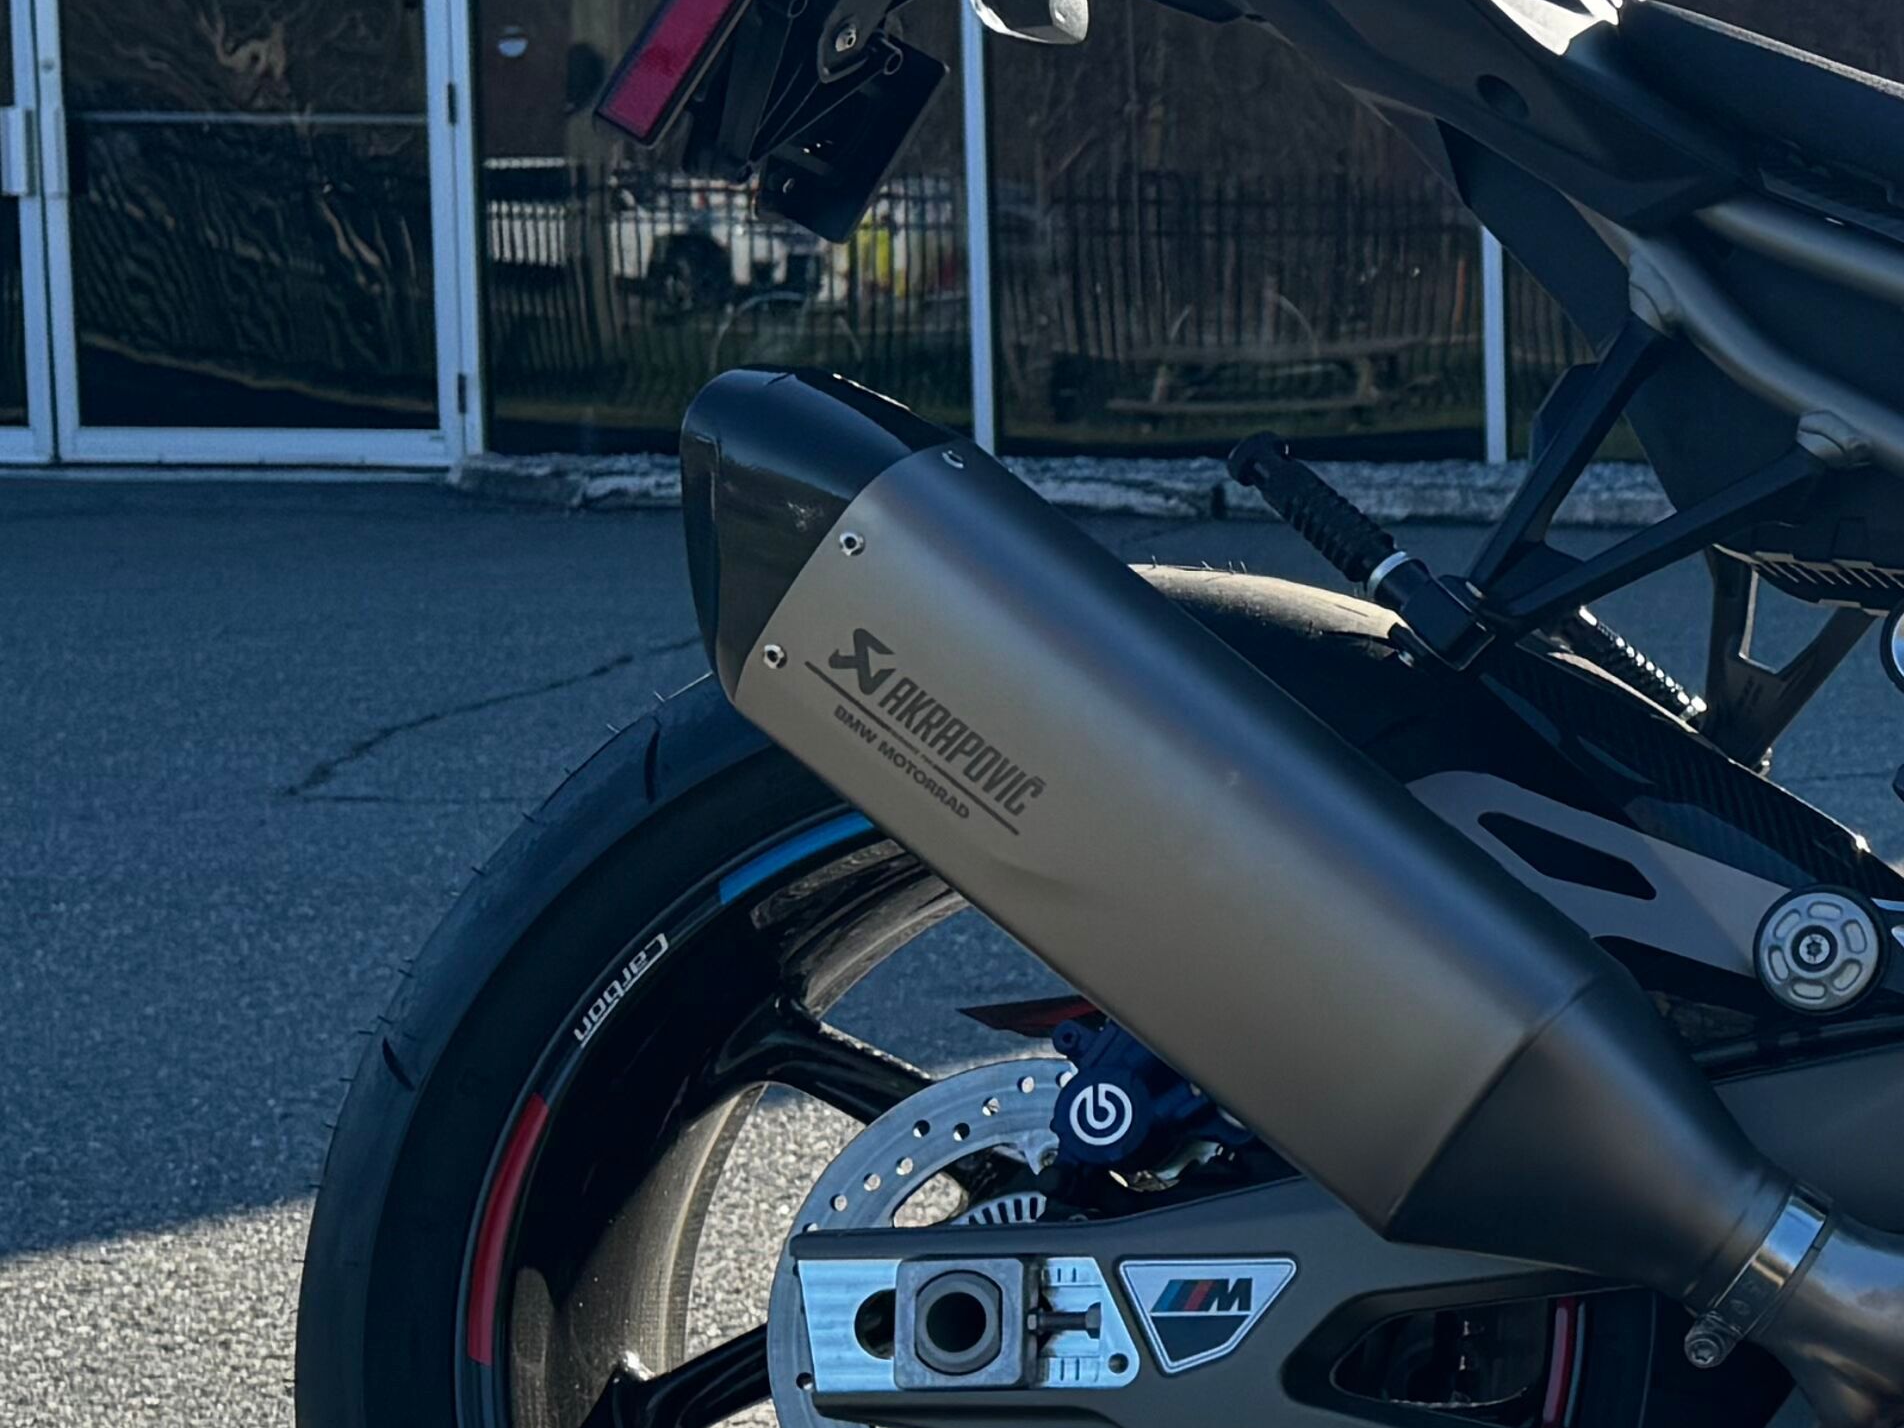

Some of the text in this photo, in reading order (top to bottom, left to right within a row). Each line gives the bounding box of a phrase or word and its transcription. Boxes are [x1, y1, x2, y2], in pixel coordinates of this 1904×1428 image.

[833, 705, 878, 744] BMW
[878, 740, 970, 820] MOTORRAD
[573, 932, 669, 1050] Carbon
